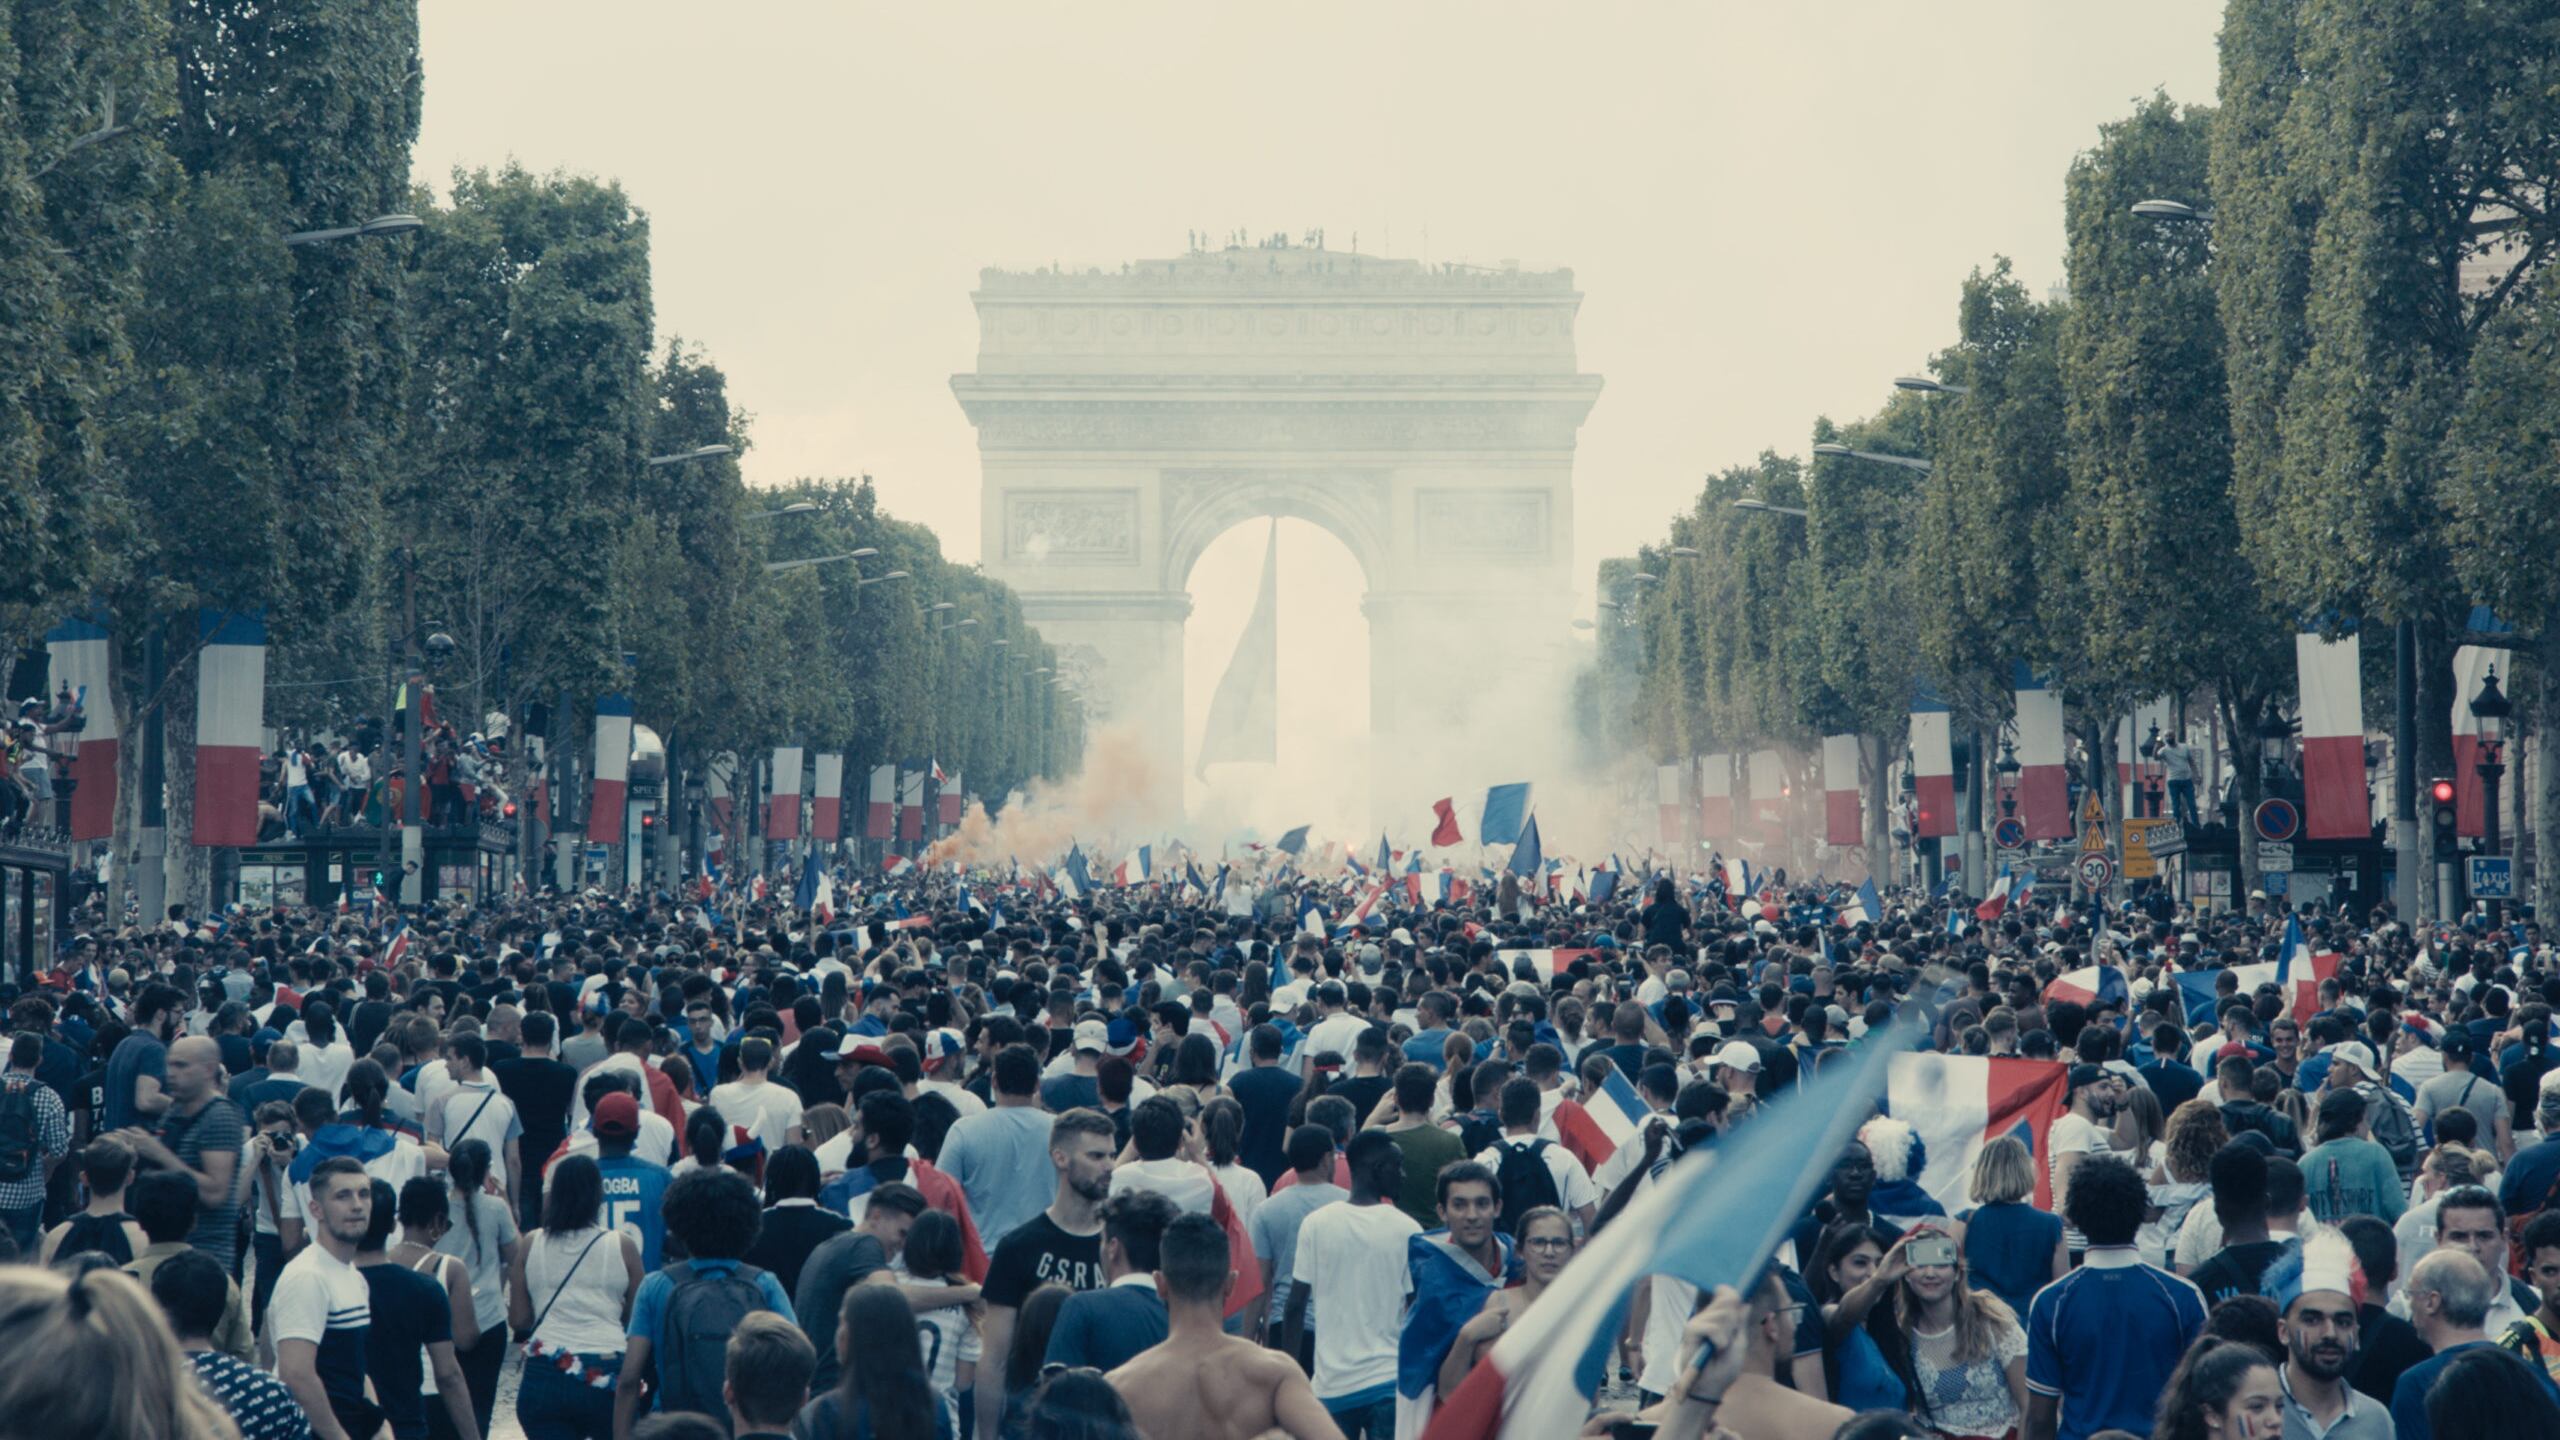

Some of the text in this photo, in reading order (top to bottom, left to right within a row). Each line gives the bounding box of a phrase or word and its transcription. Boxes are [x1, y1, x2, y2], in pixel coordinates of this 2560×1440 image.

[2085, 863, 2106, 879] 30
[2474, 871, 2510, 884] TAXIS
[602, 1176, 640, 1195] OGBA
